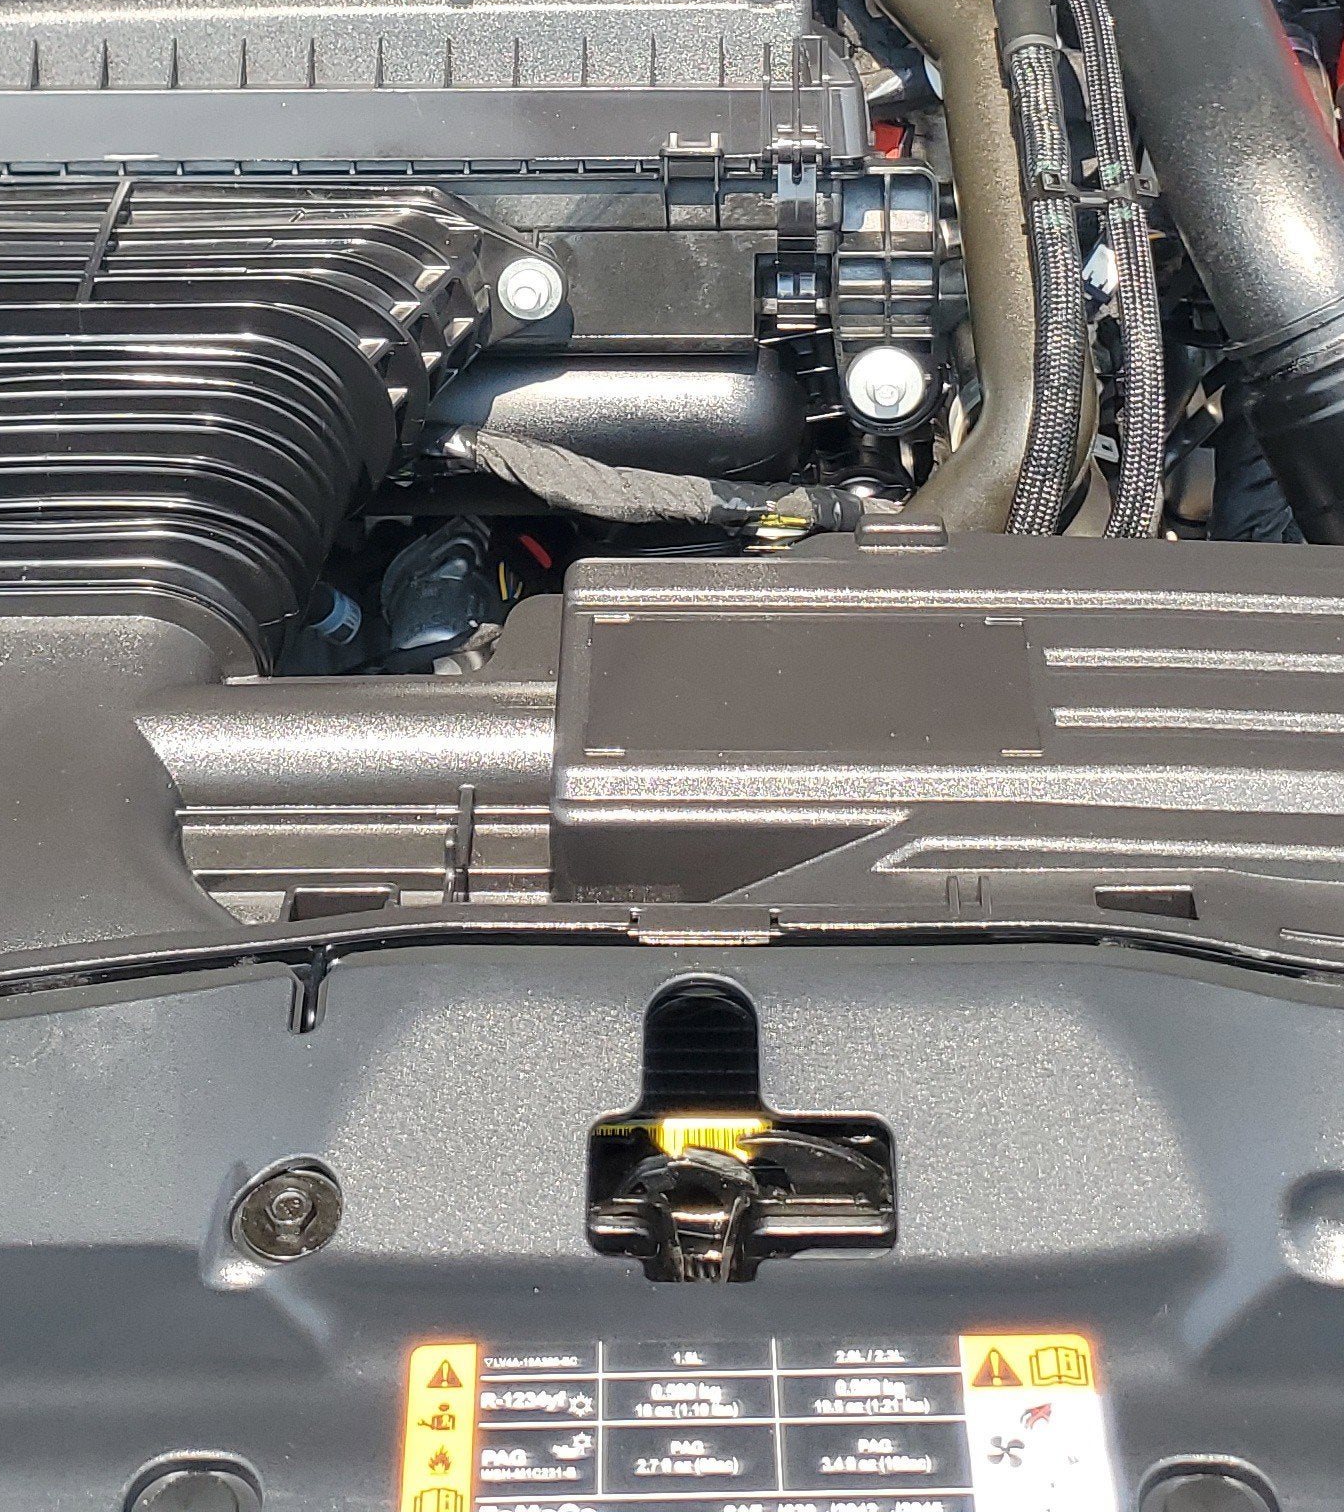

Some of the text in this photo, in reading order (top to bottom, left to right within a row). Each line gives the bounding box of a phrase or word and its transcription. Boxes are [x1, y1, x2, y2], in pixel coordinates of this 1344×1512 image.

[670, 1440, 706, 1455] PAG
[857, 1438, 894, 1454] PAG
[481, 1448, 529, 1467] PAG
